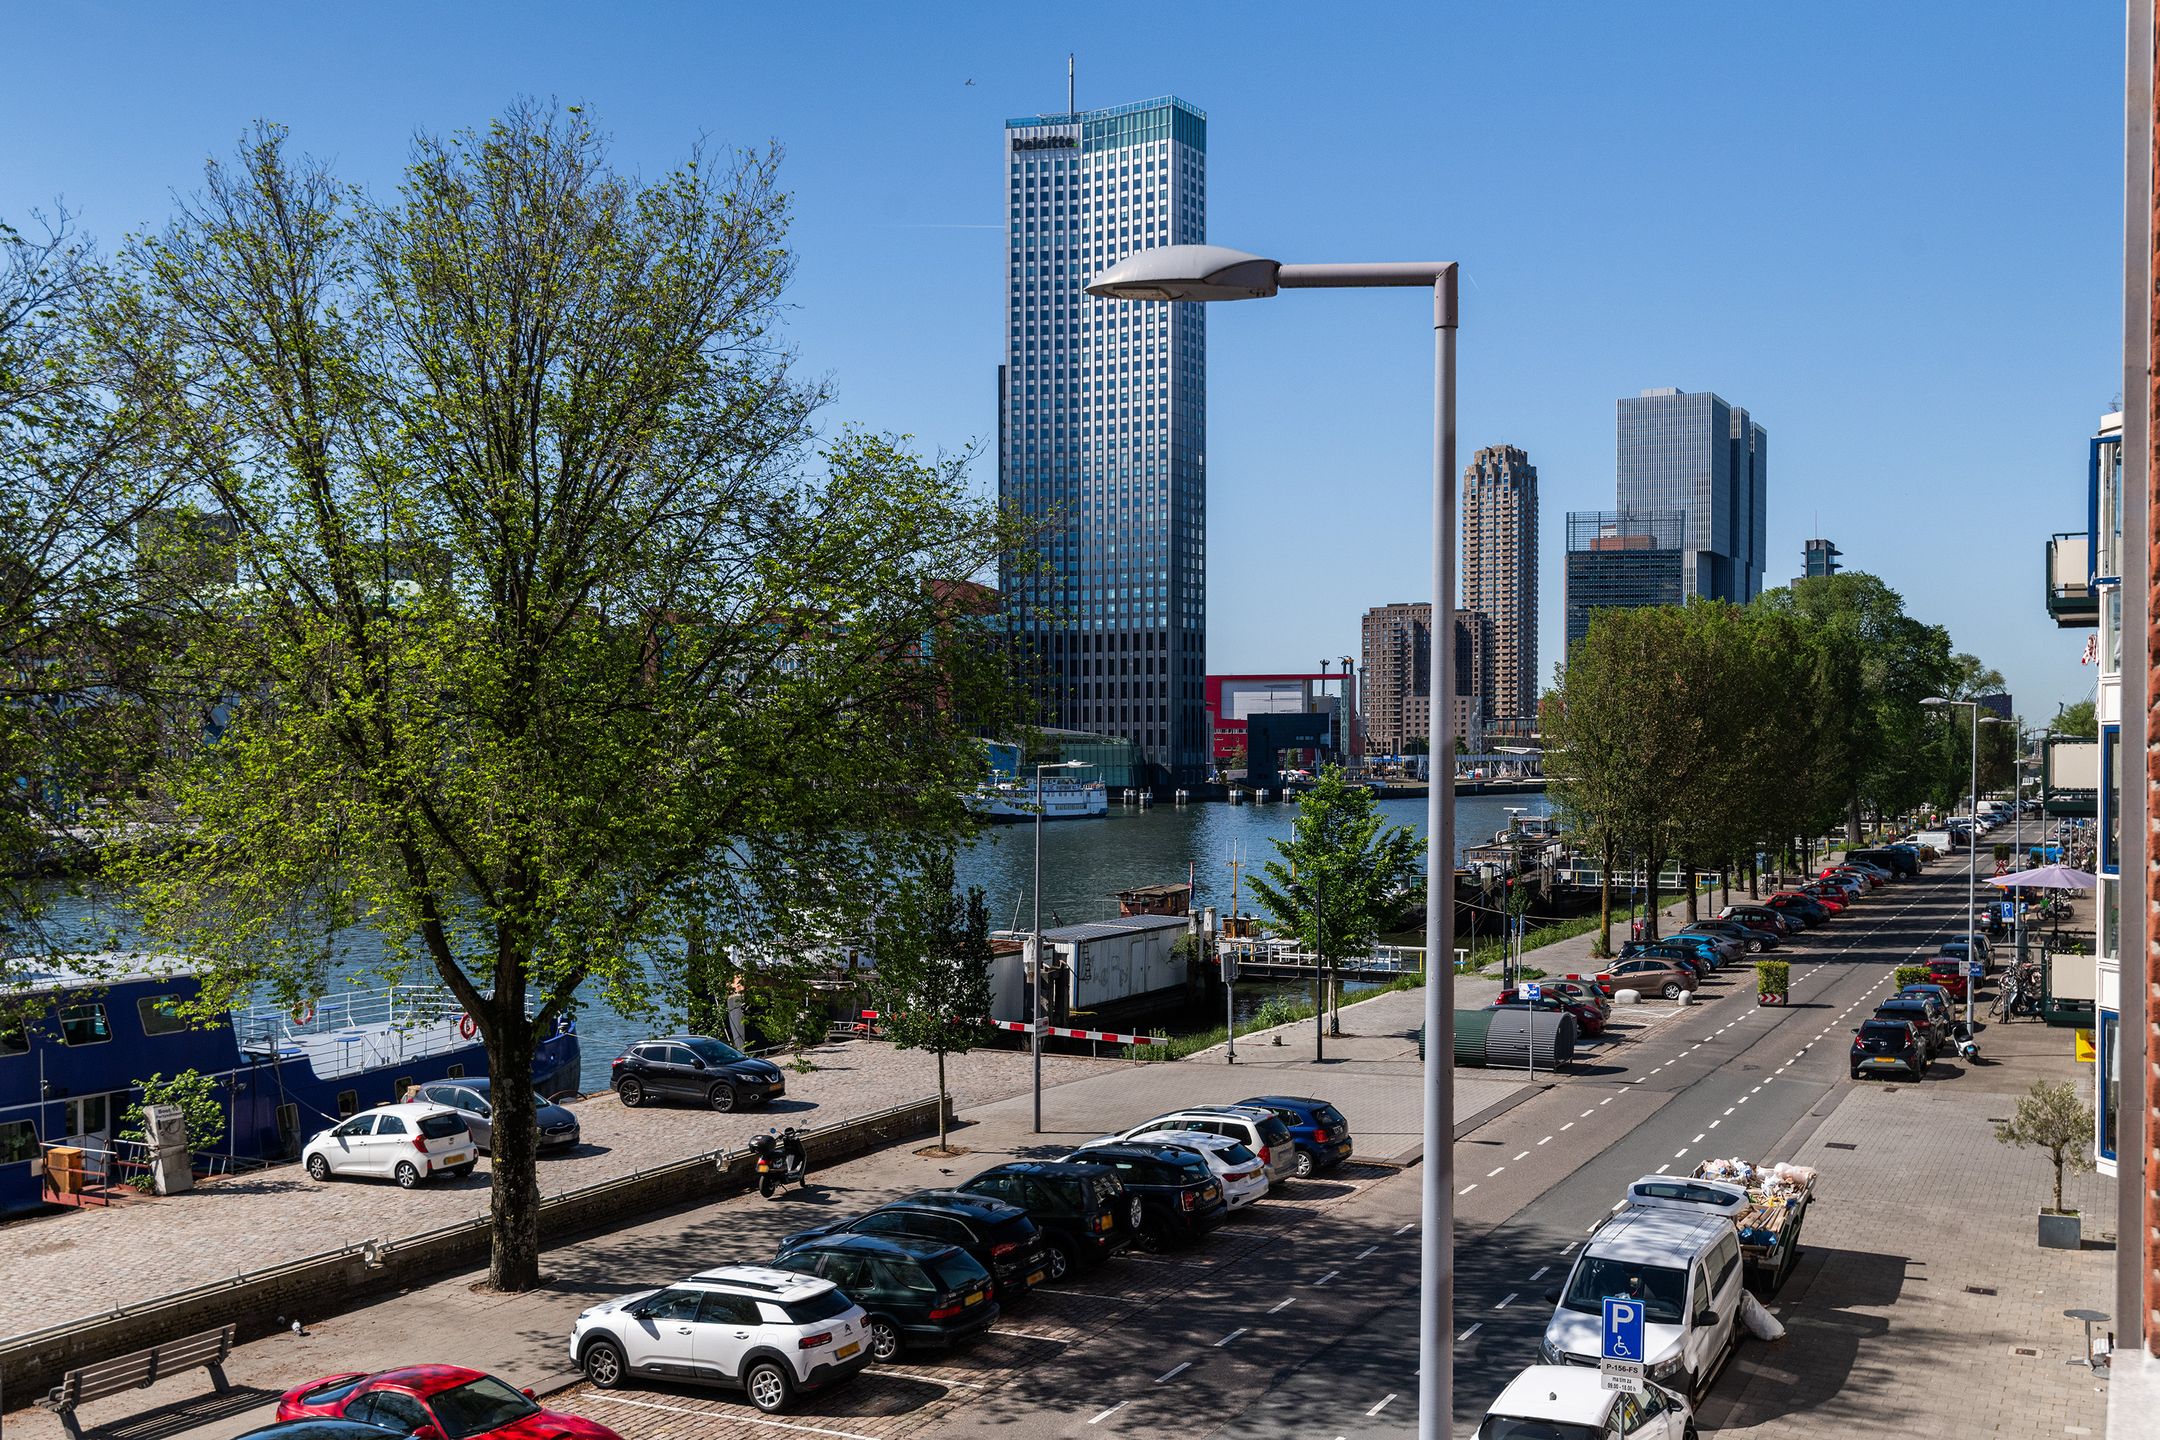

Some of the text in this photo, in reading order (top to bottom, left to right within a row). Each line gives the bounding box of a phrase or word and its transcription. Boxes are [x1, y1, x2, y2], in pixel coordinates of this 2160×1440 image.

[2004, 903, 2011, 912] P
[1611, 1303, 1634, 1333] P
[1606, 1363, 1638, 1374] P-156-FS
